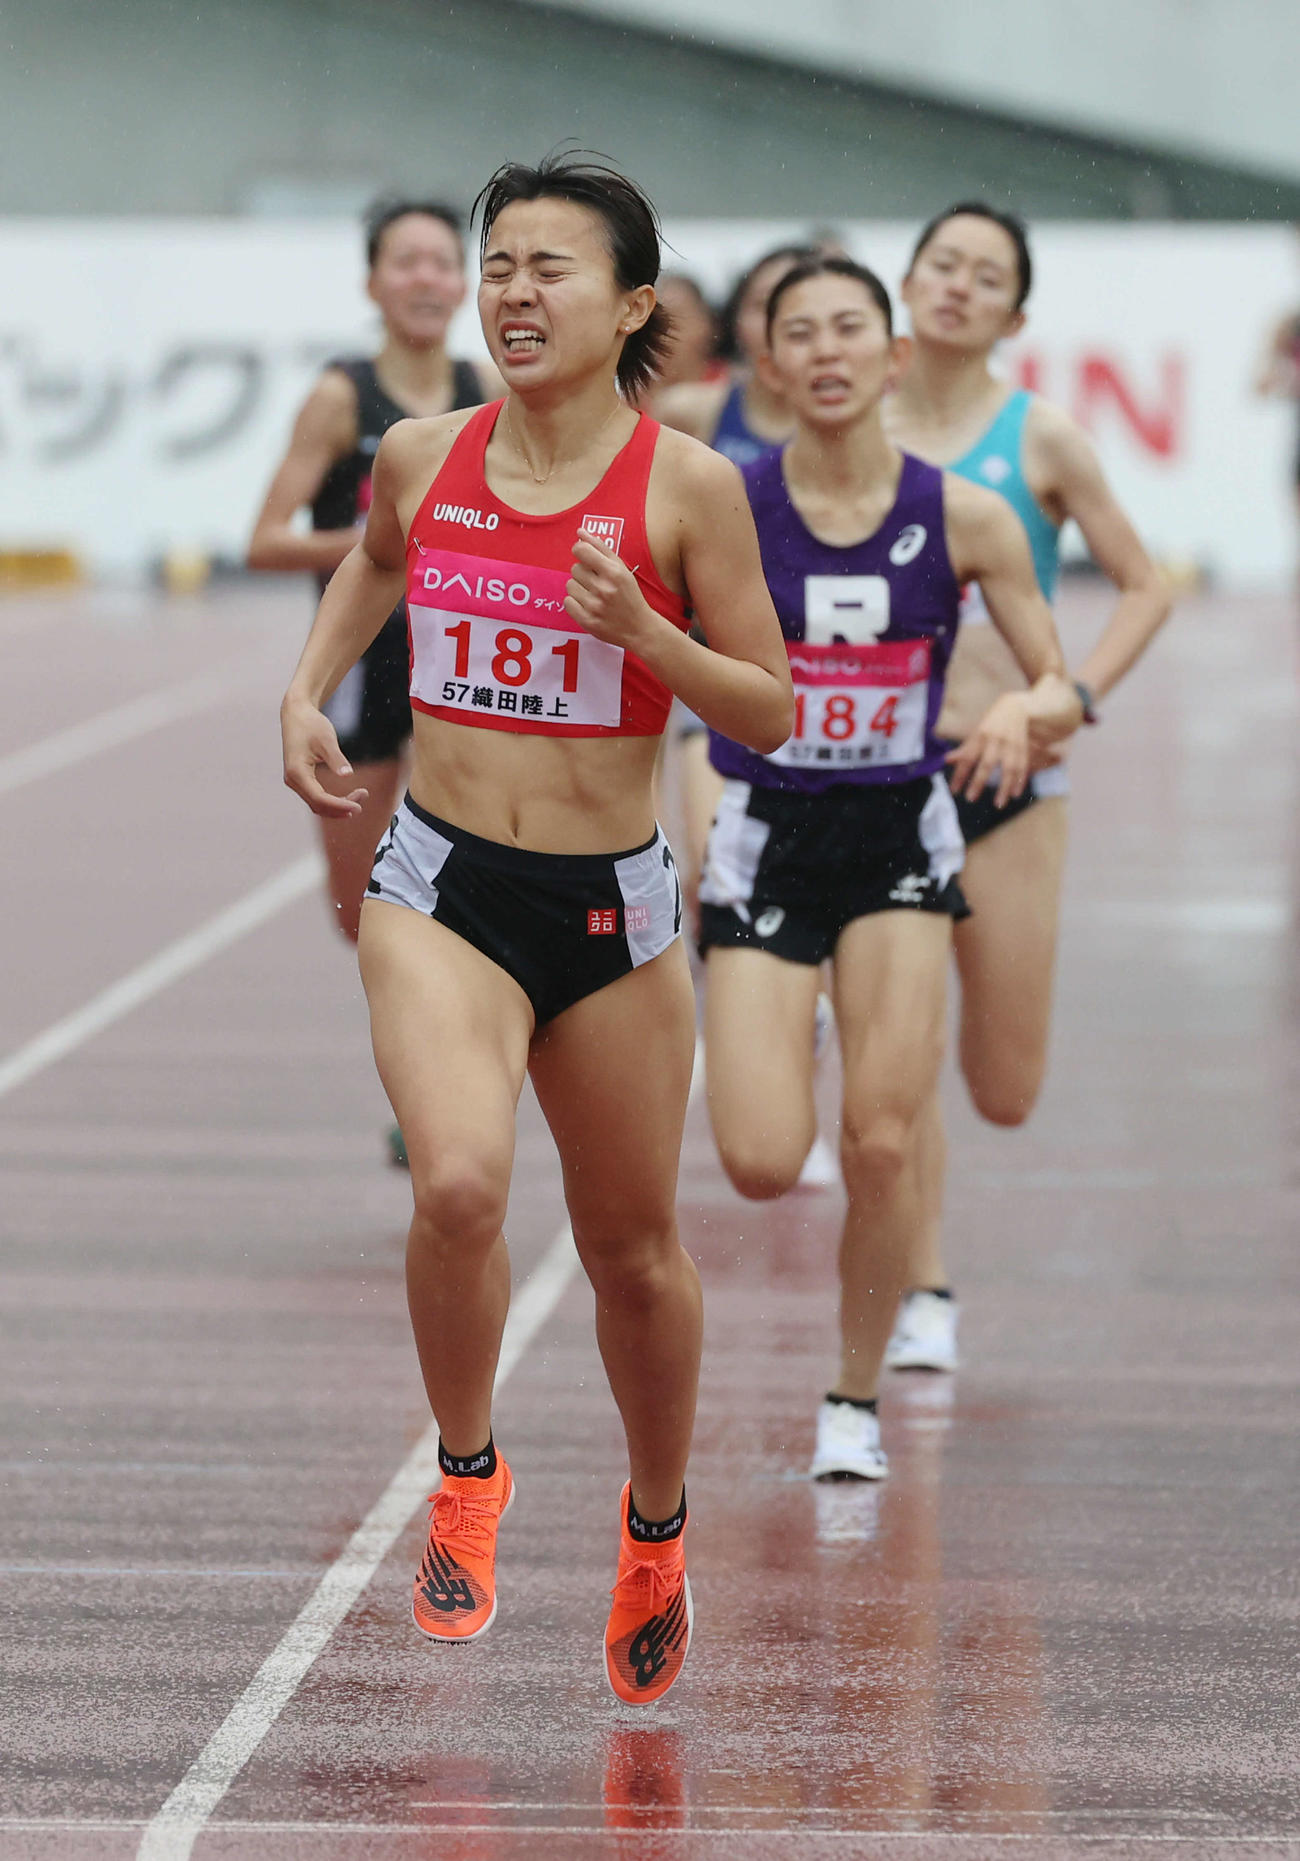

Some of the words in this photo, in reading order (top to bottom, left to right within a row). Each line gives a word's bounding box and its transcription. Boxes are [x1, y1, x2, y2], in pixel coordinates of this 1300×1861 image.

[433, 503, 499, 531] UNIQLO
[587, 520, 616, 536] UNI
[423, 567, 531, 606] DAISO
[533, 598, 566, 612] ダイソ
[804, 574, 891, 646] R
[444, 620, 580, 693] 181
[442, 682, 569, 718] 57織田陸上
[794, 693, 900, 741] 184
